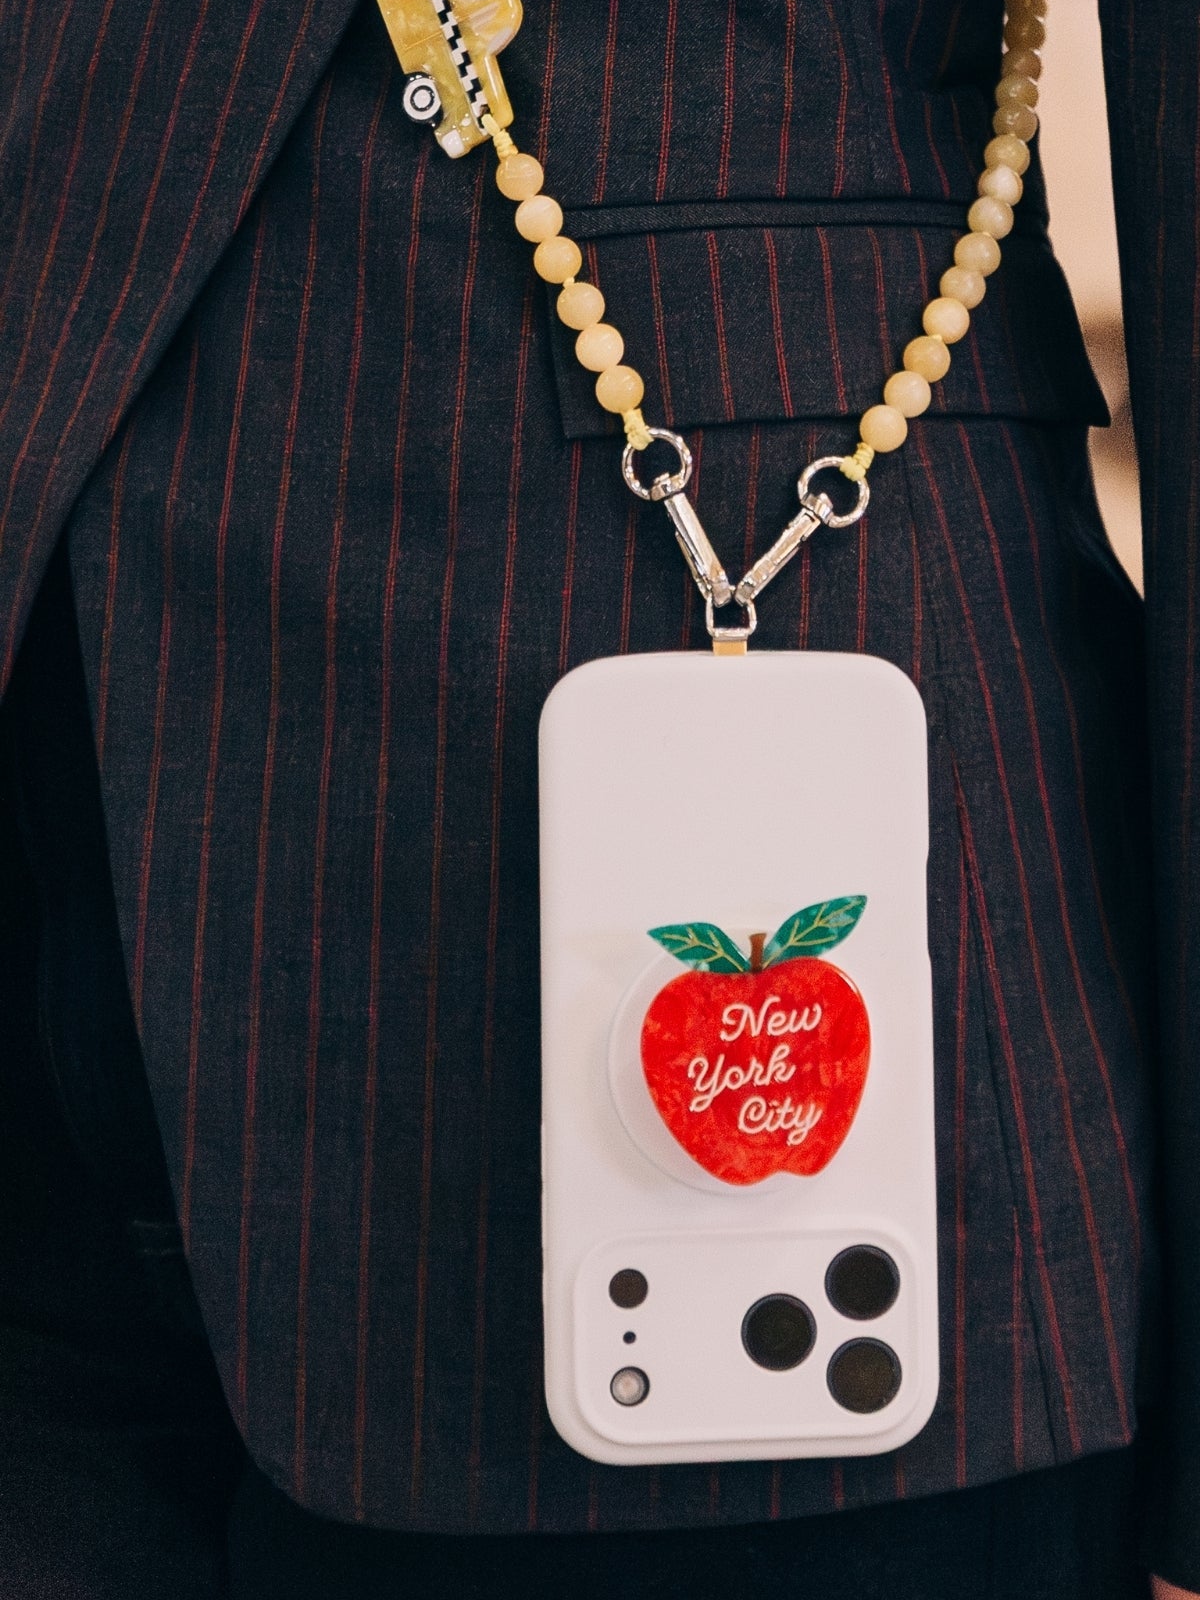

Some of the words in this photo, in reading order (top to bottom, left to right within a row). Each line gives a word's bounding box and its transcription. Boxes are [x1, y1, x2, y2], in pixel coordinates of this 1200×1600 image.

[719, 995, 823, 1042] New
[687, 1043, 797, 1113] York
[737, 1096, 824, 1147] City
